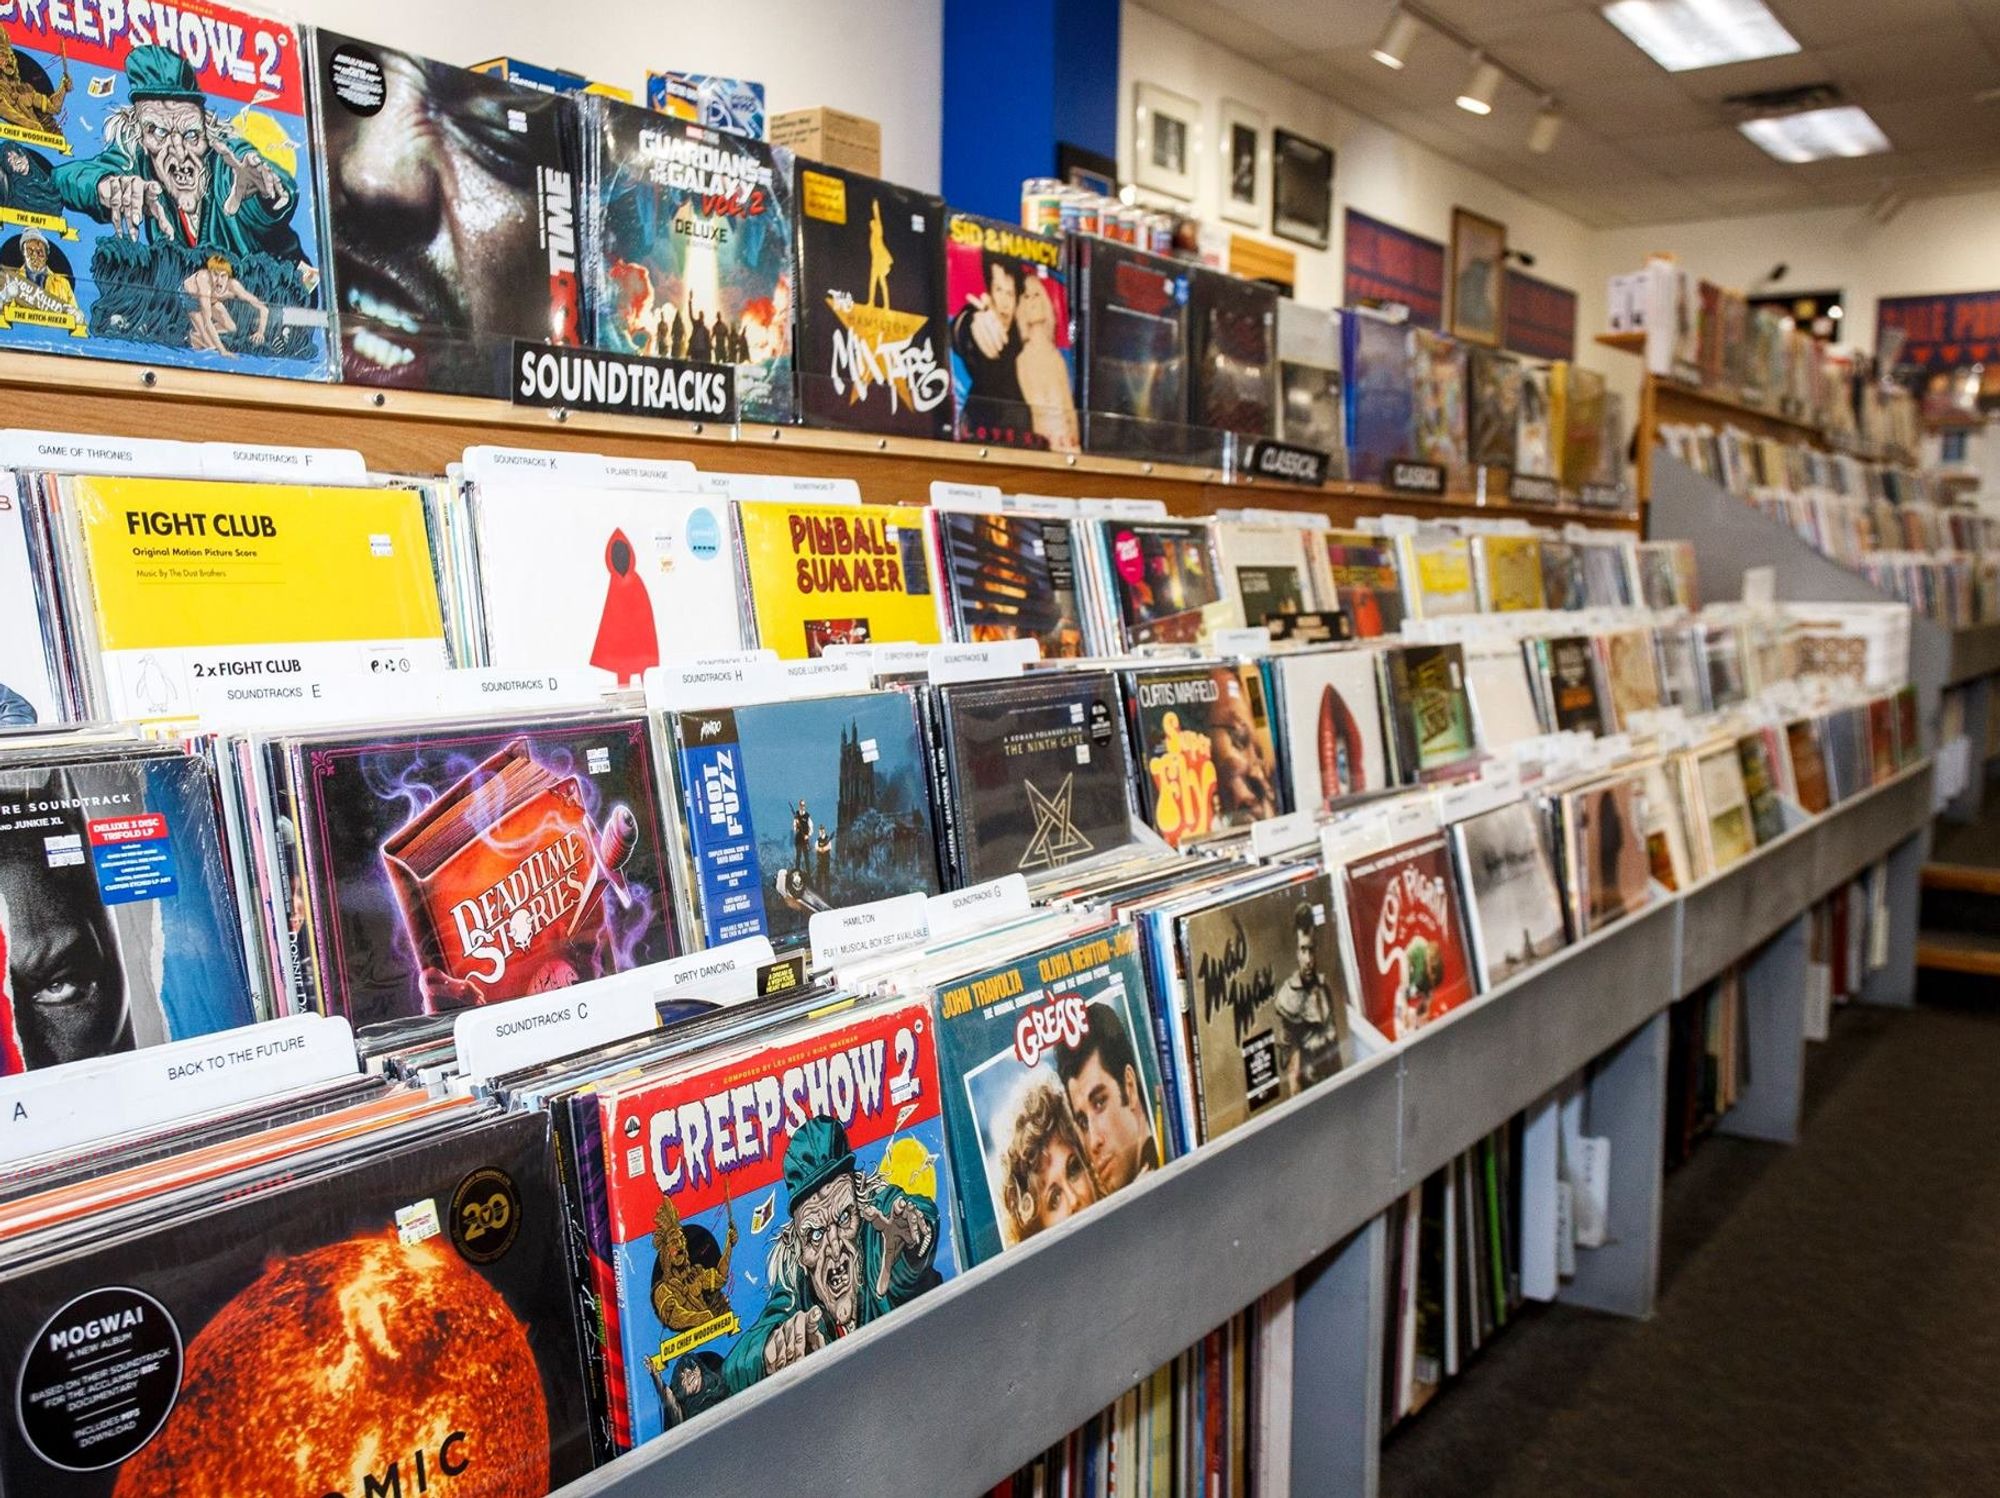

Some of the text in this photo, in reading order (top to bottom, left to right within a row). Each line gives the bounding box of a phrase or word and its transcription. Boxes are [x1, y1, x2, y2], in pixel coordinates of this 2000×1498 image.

[255, 31, 283, 90] 2
[4, 127, 63, 147] CHIEF WOODENHEAD
[638, 129, 761, 181] GUARDIANS
[667, 163, 756, 205] GALAXY
[749, 190, 767, 217] 2
[16, 213, 46, 226] THE RAFT
[674, 218, 728, 244] DELUXE
[950, 217, 1060, 266] SID & NANCY
[14, 311, 26, 320] THE
[519, 350, 728, 415] SOUNDTRACKS
[38, 444, 133, 461] GAME OF THRONES
[232, 450, 313, 466] SOUNDTRACKS F
[493, 454, 558, 470] SOUNDTRACKS K
[126, 511, 277, 538] FIGHT CLUB
[788, 515, 898, 556] PINBALL
[132, 547, 257, 558] Original Motion Picture Score
[136, 569, 157, 578] Music
[159, 570, 168, 580] By
[183, 570, 198, 578] Dust
[199, 570, 226, 578] Brothers
[796, 558, 903, 594] SUMMER
[193, 658, 302, 678] 2 x FIGHT CLUB
[788, 667, 808, 678] INSIDE
[808, 665, 831, 676] LLEWYN
[943, 654, 981, 664] SOUNDTRACKS
[227, 683, 322, 701] SOUNDTRACKS E
[481, 677, 558, 692] SOUNDTRACKS D
[682, 671, 743, 684] SOUNDTRACKS H
[1138, 679, 1220, 708] CURTIS MAYFIELD
[1004, 733, 1084, 756] THE NINTH GATE
[28, 793, 131, 813] SOUNDTRACK
[703, 763, 727, 824] HOT
[717, 749, 743, 837] FUZZ
[13, 817, 50, 830] JUNKIE
[50, 816, 64, 826] XL
[93, 821, 130, 833] DELUXE
[138, 818, 160, 828] DISC
[102, 828, 155, 841] TRIFOLD LP
[450, 830, 586, 959] DEADTIME
[952, 885, 1001, 909] SOUNDTRACKS G
[842, 914, 876, 927] HAMILTON
[840, 940, 869, 955] MUSICAL
[869, 937, 882, 949] BOX
[883, 934, 896, 945] SET
[896, 927, 929, 942] AVAILABLE
[288, 931, 304, 988] DONNIE
[674, 959, 736, 985] DIRTY DANCING
[1037, 952, 1073, 983] OLIVIA
[942, 968, 1025, 1020] JOHN TRAVOLTA
[495, 1003, 589, 1038] SOUNDTRACKS C
[1015, 997, 1089, 1069] GREASE
[13, 1035, 306, 1121] A BACK TO THE FUTURE
[723, 1066, 761, 1084] COMPOSED
[761, 1063, 773, 1074] BY
[772, 1058, 787, 1070] LES
[787, 1051, 806, 1065] REED
[812, 1045, 828, 1056] RICK
[649, 1038, 886, 1194] CREEPSHOW
[892, 1027, 920, 1099] 2
[462, 1192, 510, 1241] 20
[50, 1306, 145, 1352] MOGWAI
[663, 1316, 732, 1356] OLD CHIEF WOODENHEAD
[66, 1331, 133, 1361] A NEW ALBUM
[29, 1347, 171, 1404] BASED ON THEIR SOUNDTRACK
[44, 1361, 160, 1409] FOR THE ACCLAIMED BBC
[66, 1380, 139, 1413] DOCUMENTARY
[73, 1407, 141, 1440] INCLUDES MP3
[79, 1420, 137, 1449] DOWNLOAD
[319, 1430, 470, 1498] MIC
